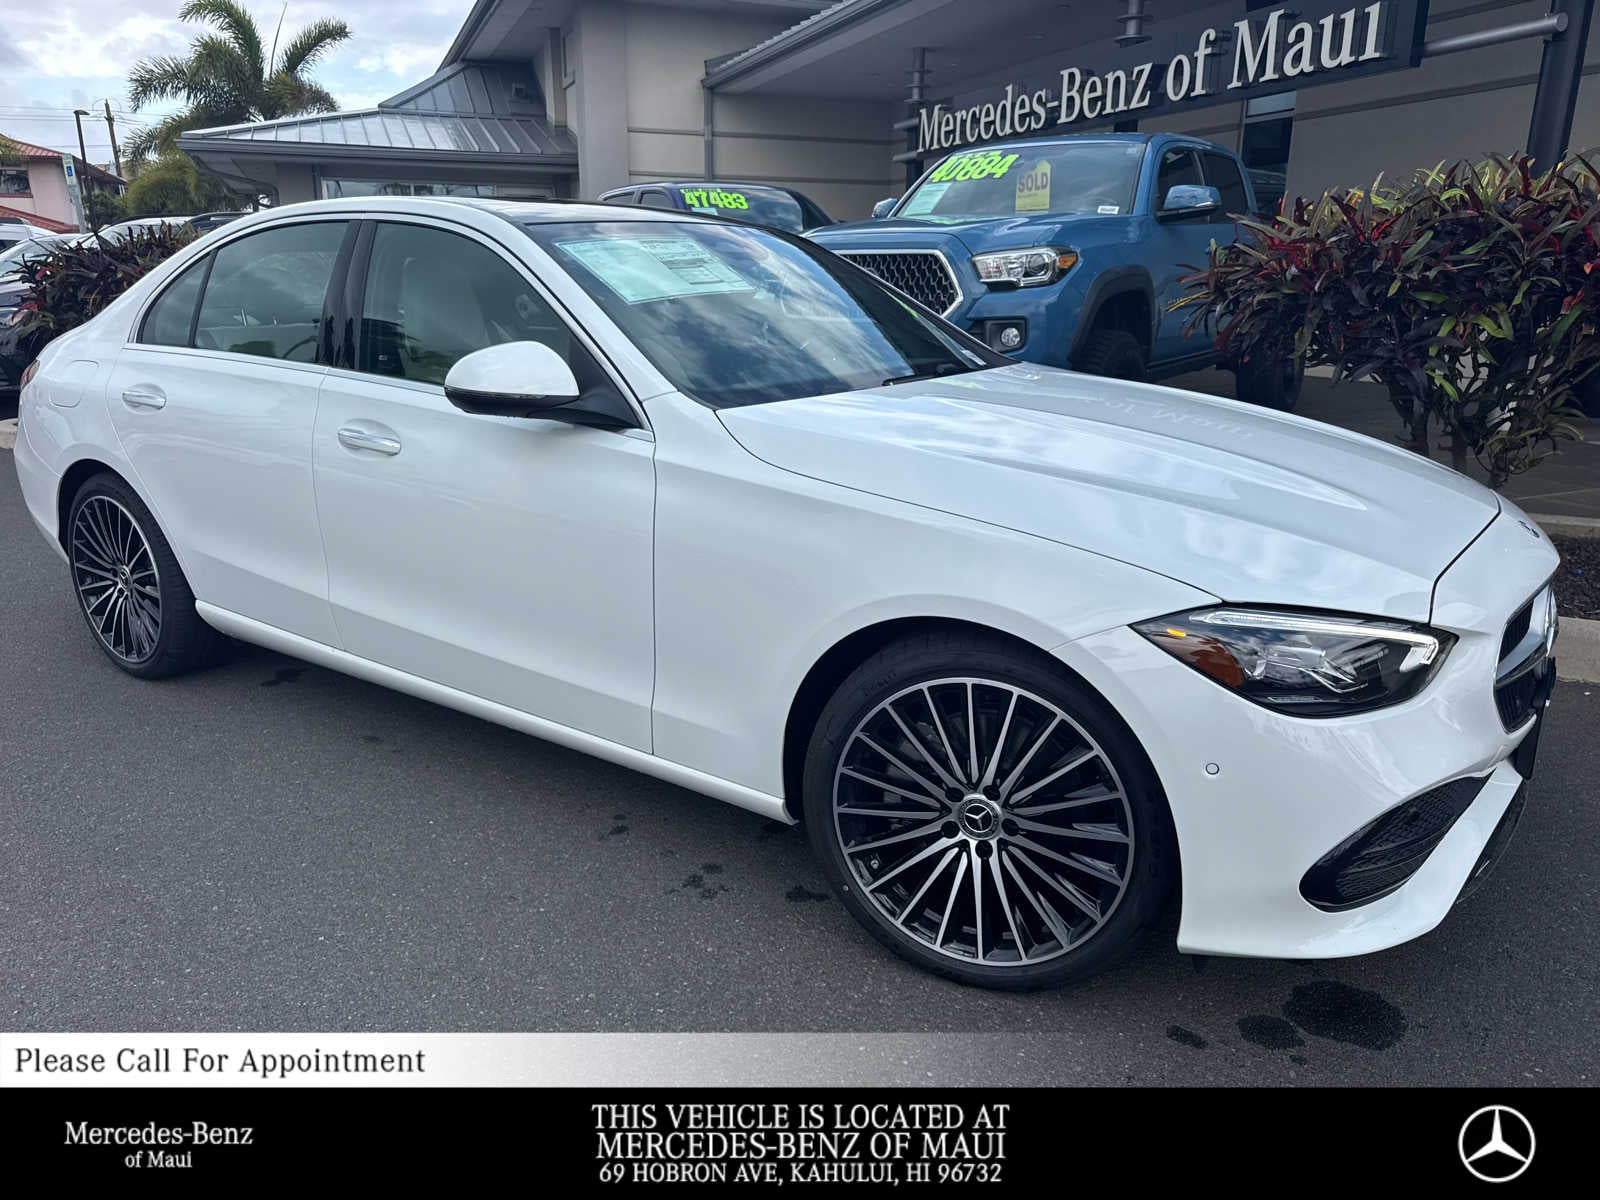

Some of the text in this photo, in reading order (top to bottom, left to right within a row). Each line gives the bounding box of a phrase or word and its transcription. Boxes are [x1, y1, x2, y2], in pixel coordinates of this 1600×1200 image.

[916, 1, 1381, 153] Mercedes-Benz of Maui
[928, 153, 1020, 182] 40884
[1017, 172, 1050, 193] SOLD
